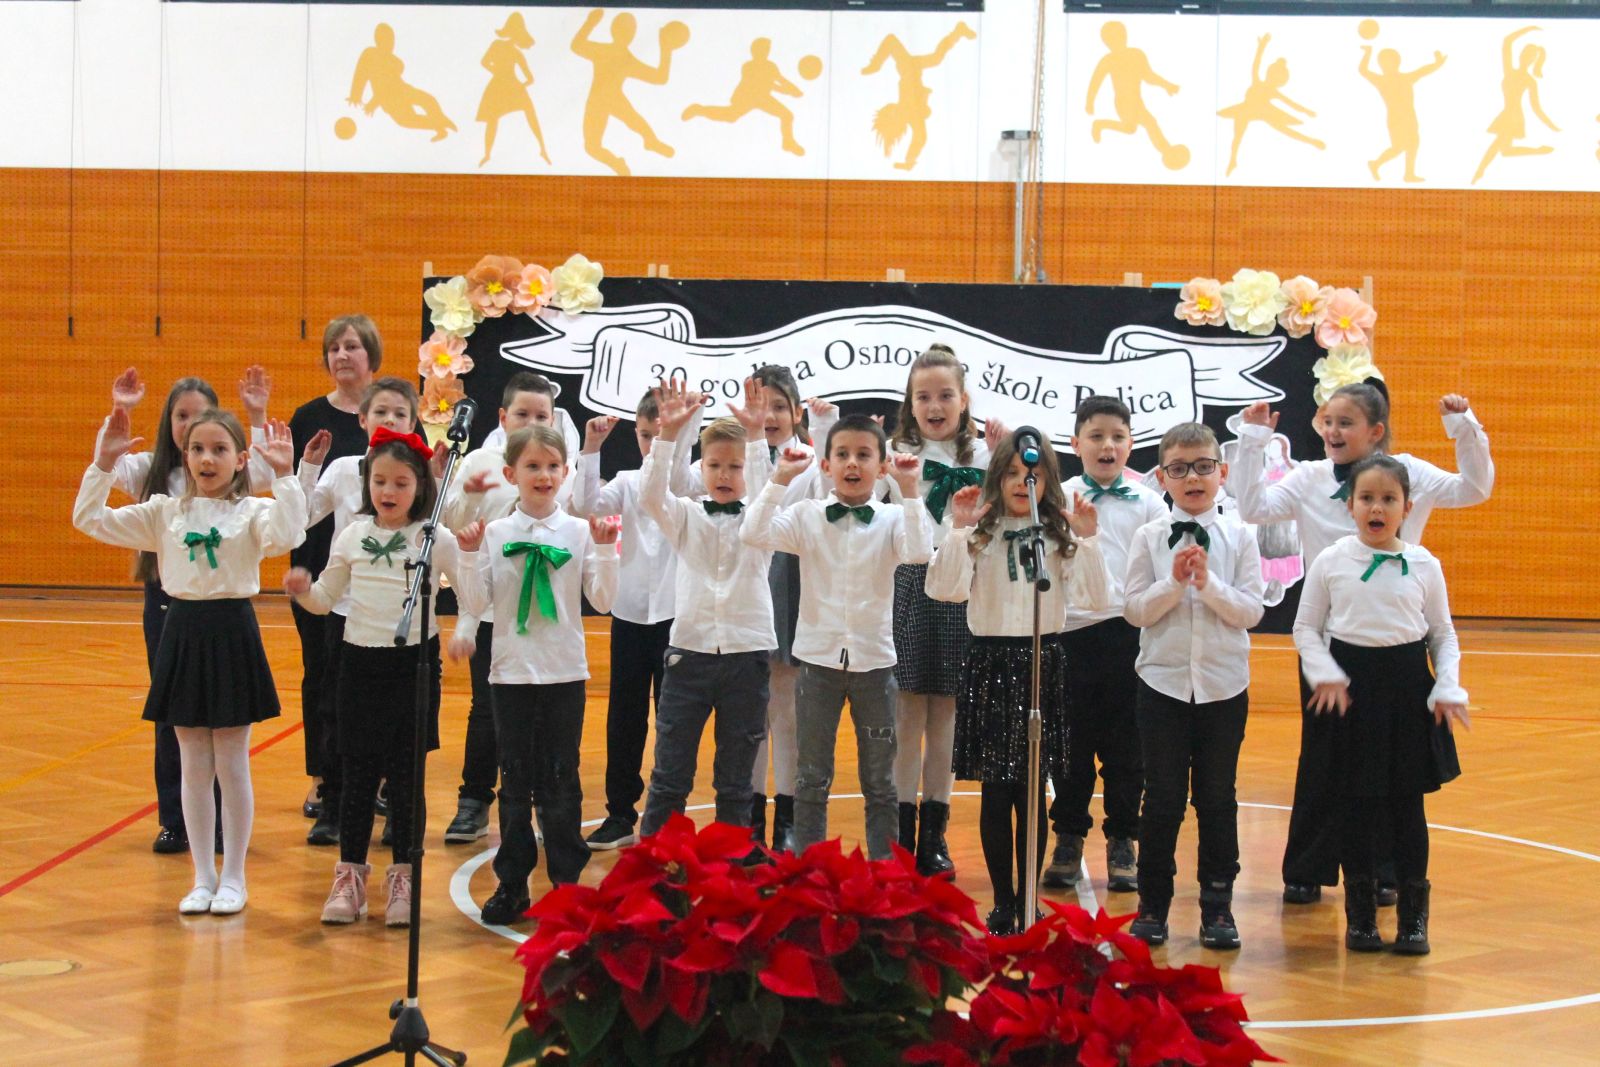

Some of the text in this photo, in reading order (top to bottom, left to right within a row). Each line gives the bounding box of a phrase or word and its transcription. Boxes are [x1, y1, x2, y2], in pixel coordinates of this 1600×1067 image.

[700, 360, 815, 407] goa
[824, 339, 969, 373] Osno
[979, 361, 1058, 409] škole
